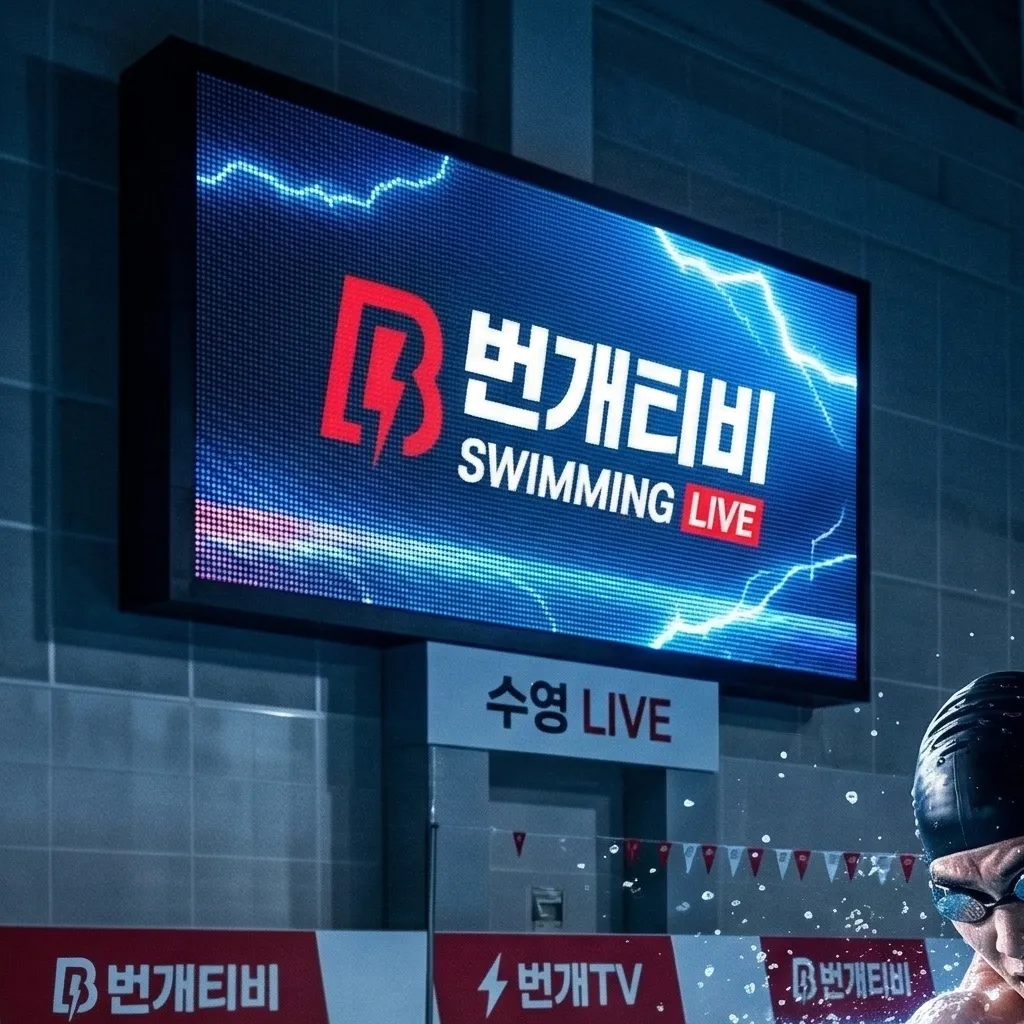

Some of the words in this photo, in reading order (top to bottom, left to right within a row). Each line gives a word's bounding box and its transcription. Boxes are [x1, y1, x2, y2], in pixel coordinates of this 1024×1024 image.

[464, 309, 776, 485] 번개티비
[457, 438, 675, 524] SWIMMING
[688, 491, 757, 538] LIVE
[486, 675, 568, 734] 수영
[583, 688, 672, 743] LIVE
[107, 963, 279, 1014] 번개티비
[518, 962, 643, 1009] 번개TV
[819, 961, 912, 1000] 번개티비
